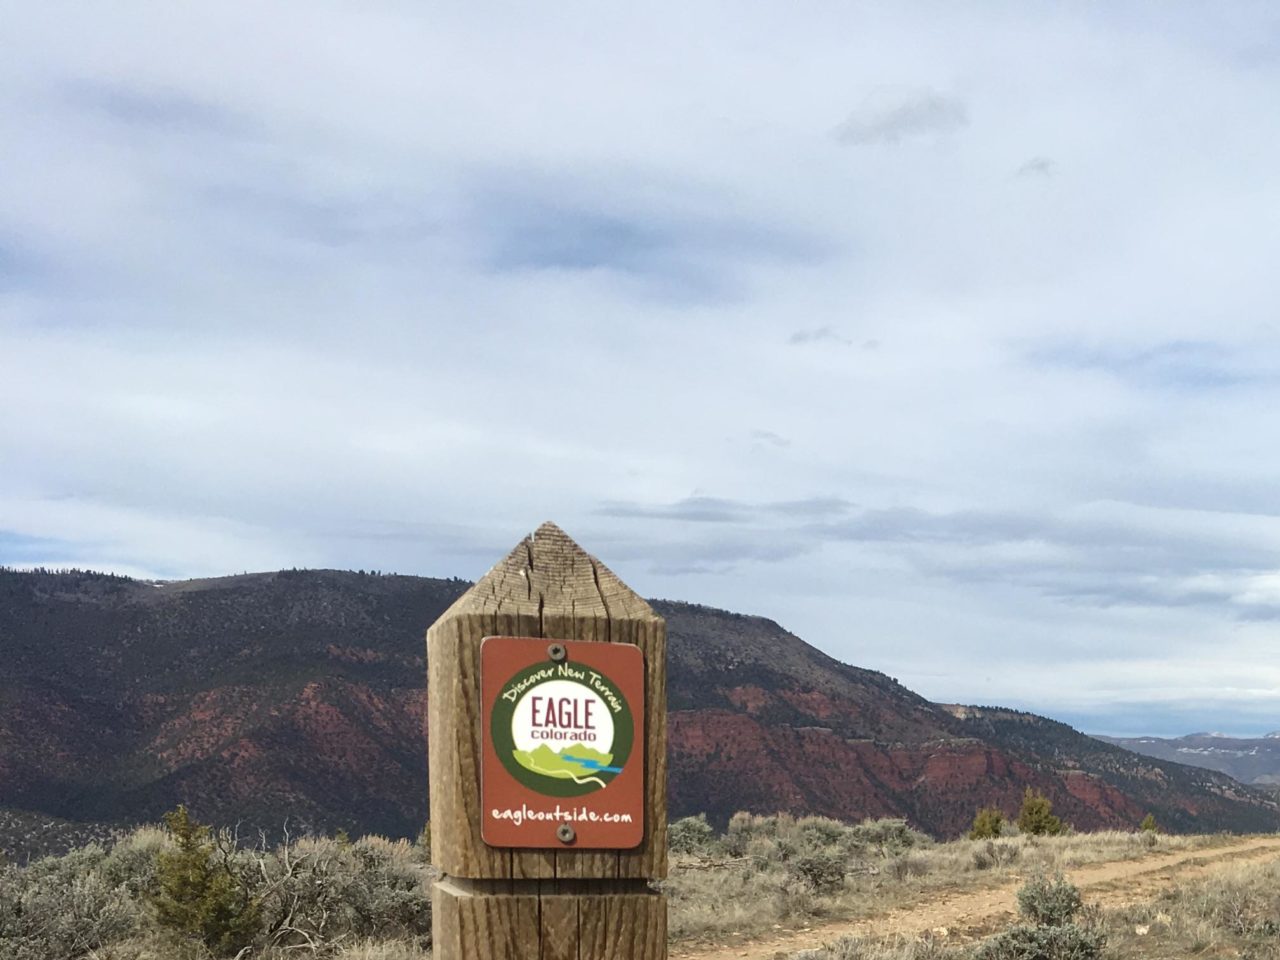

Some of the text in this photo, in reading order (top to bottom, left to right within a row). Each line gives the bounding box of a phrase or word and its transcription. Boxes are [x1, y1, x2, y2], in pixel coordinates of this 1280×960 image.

[502, 663, 622, 713] Discover New Terrain
[531, 696, 596, 730] EAGLE
[531, 728, 597, 742] colorado
[492, 804, 632, 826] eagleoutside.com
